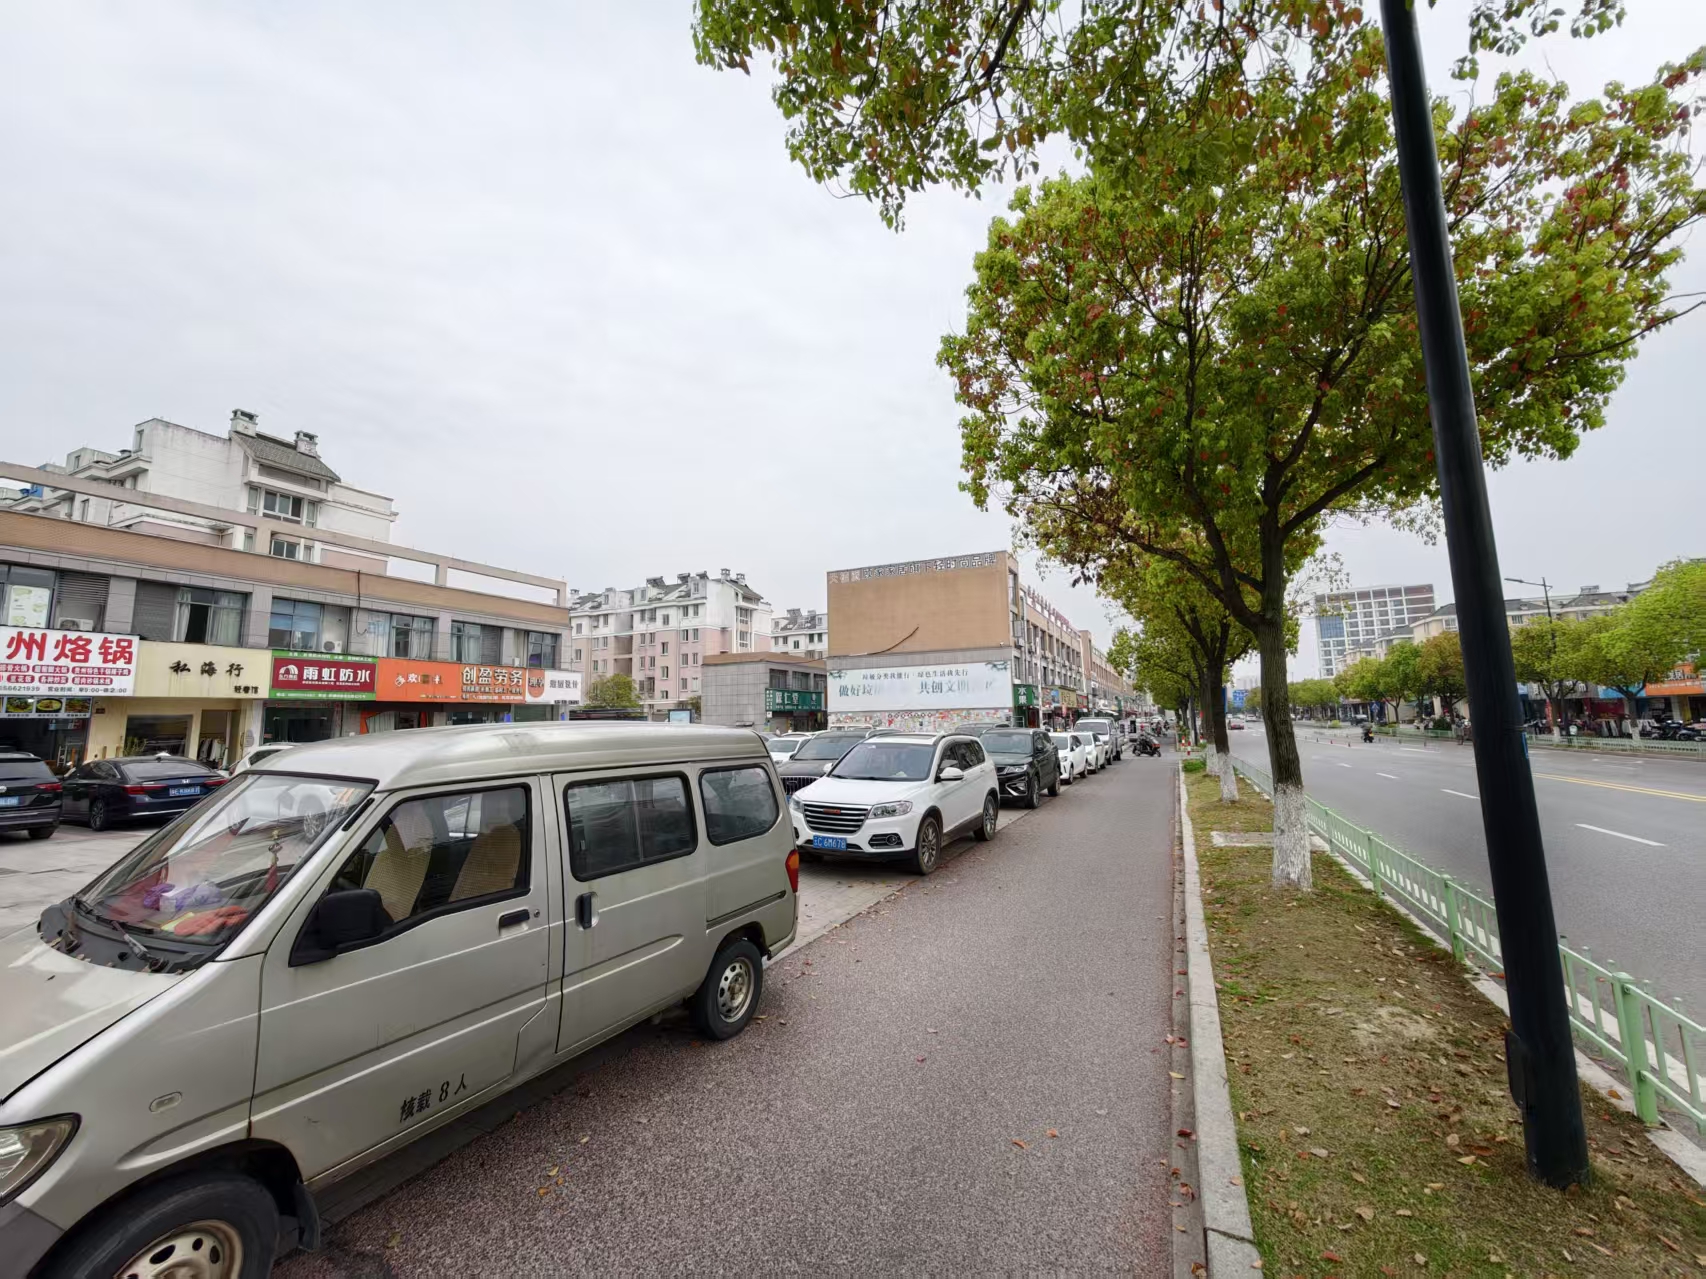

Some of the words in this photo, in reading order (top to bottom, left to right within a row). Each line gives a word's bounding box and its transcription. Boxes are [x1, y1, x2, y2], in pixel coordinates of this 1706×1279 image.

[7, 630, 134, 665] 州烙锅
[303, 666, 371, 683] 雨虹防水
[462, 666, 523, 686] 创盈劳务
[1017, 687, 1028, 705] 水果
